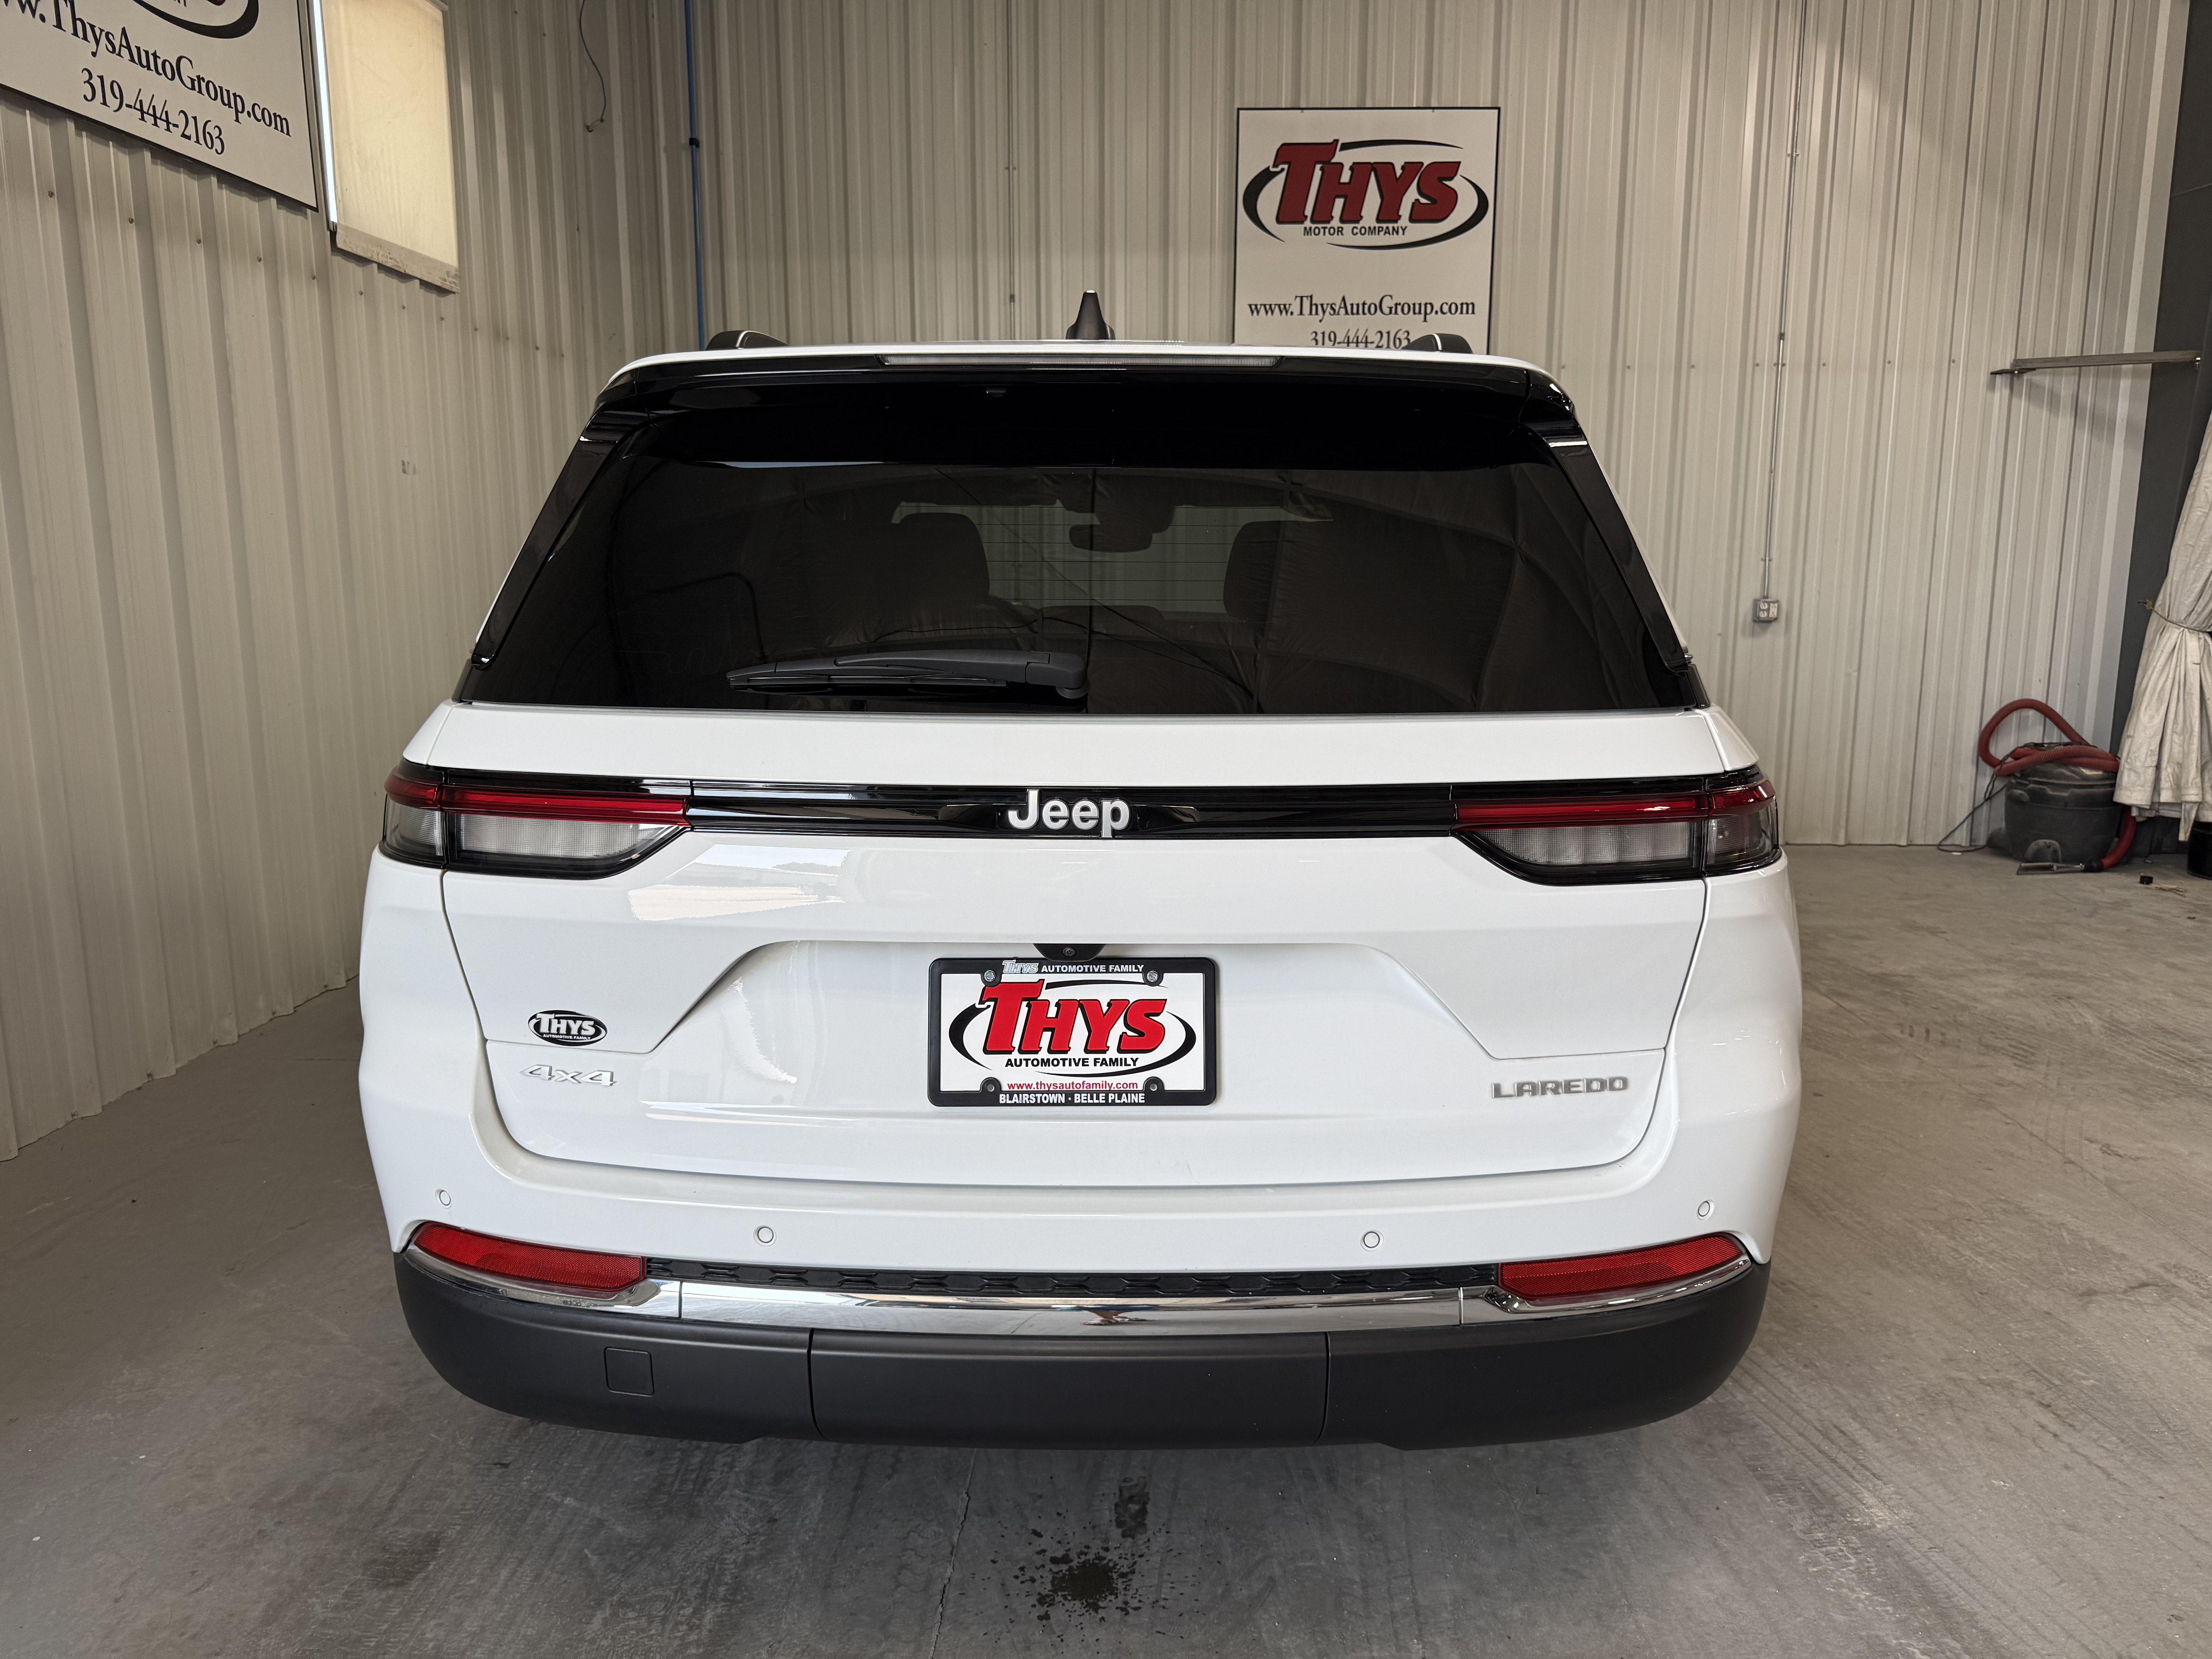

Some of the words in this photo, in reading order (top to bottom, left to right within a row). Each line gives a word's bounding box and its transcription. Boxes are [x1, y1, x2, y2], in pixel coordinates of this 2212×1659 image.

[3, 0, 292, 137] w.ThysAutoGroup.com
[81, 68, 225, 155] 319-444-2163
[1272, 139, 1462, 225] THYS
[1303, 227, 1344, 237] MOTOR
[1351, 226, 1407, 236] COMPANY
[1248, 294, 1476, 323] www.ThysAutoGroup.com
[1311, 328, 1411, 349] 319-444-2163
[1007, 788, 1130, 838] Jeep
[1002, 960, 1039, 974] THYS
[1041, 965, 1106, 973] AUTOMOTIVE
[1109, 964, 1144, 972] FAMILY
[536, 1013, 595, 1036] THYS
[978, 979, 1168, 1054] THYS
[1005, 1058, 1089, 1067] AUTOMOTIVE
[1093, 1058, 1139, 1067] FAMILY
[520, 1064, 615, 1087] 4x4
[1007, 1080, 1139, 1091] www.thysautofamily.com
[1491, 1075, 1628, 1099] LAREDO
[999, 1093, 1065, 1104] BLAIRSTOWN
[1074, 1093, 1106, 1104] BELLE
[1108, 1092, 1146, 1103] PLAINE
